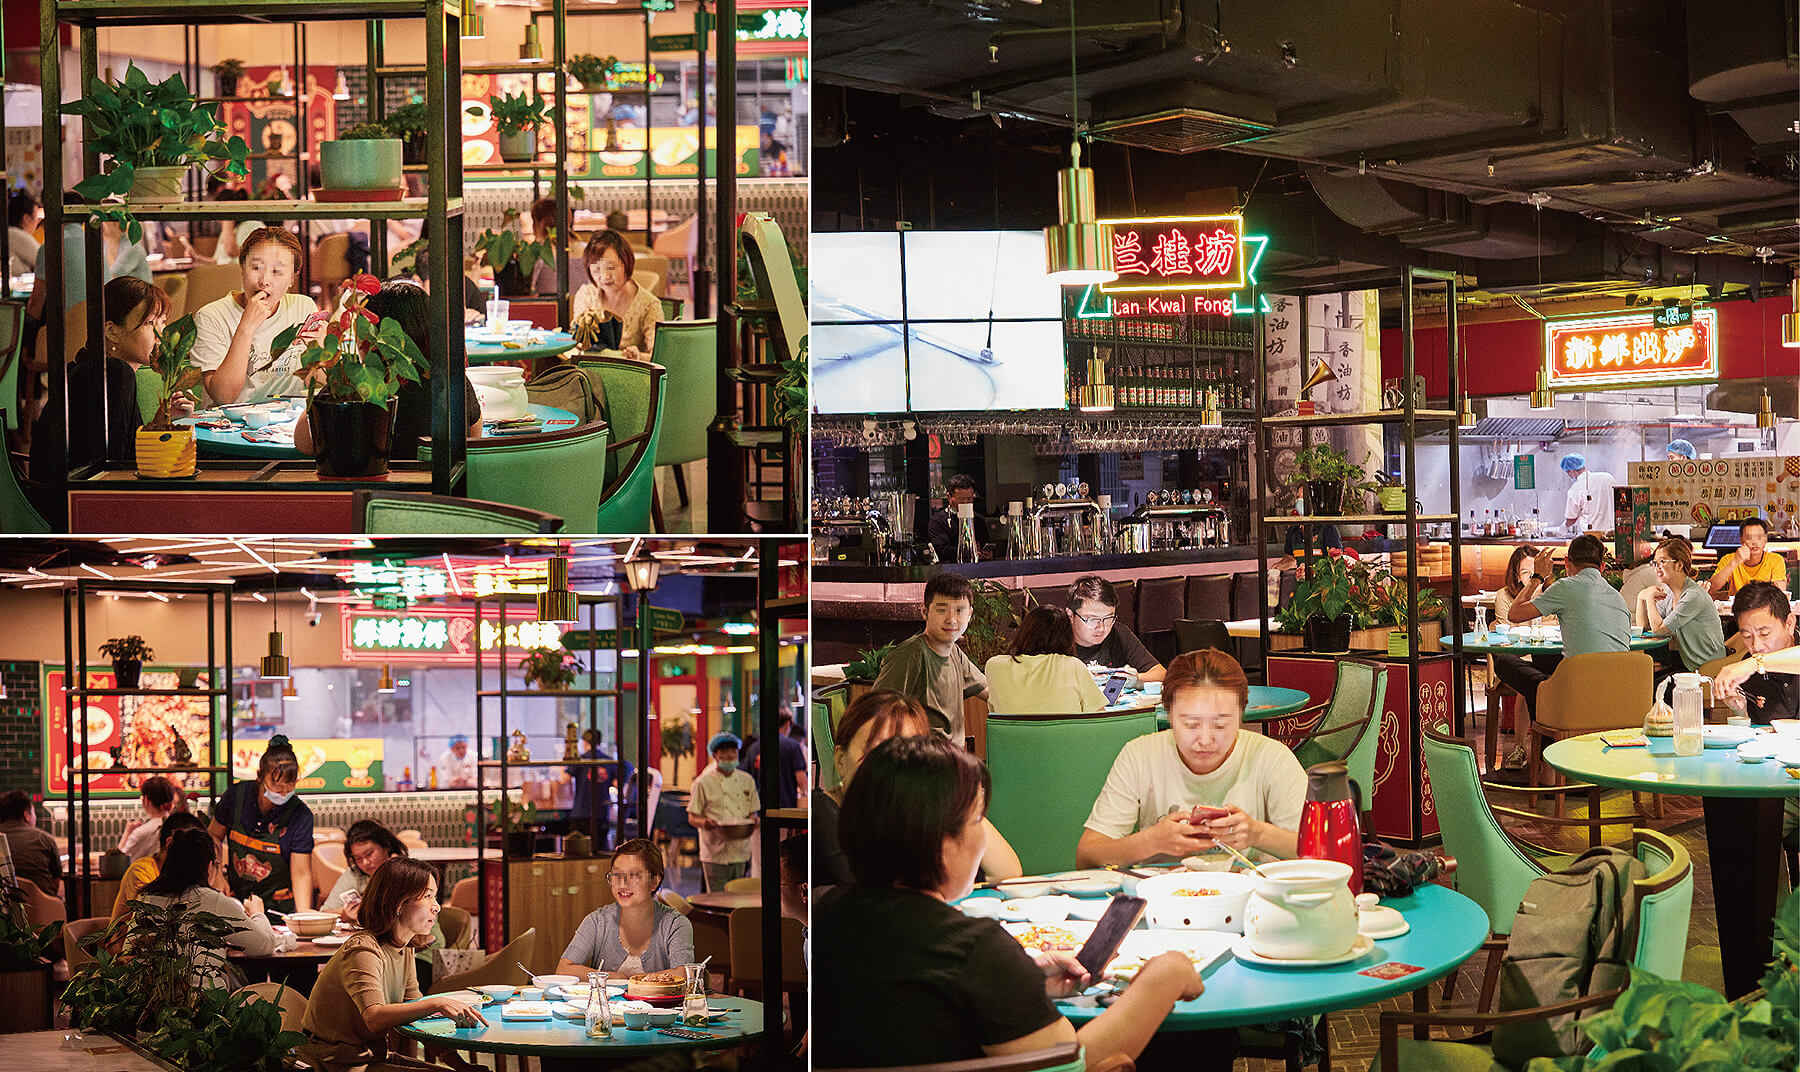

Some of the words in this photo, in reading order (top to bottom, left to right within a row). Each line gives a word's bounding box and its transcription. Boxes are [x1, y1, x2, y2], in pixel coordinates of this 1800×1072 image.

[1113, 228, 1237, 277] 兰桂坊
[1113, 298, 1140, 316] Lan
[1194, 295, 1233, 317] Fong
[1266, 298, 1293, 356] 香油坊
[1336, 341, 1354, 401] 香油坊
